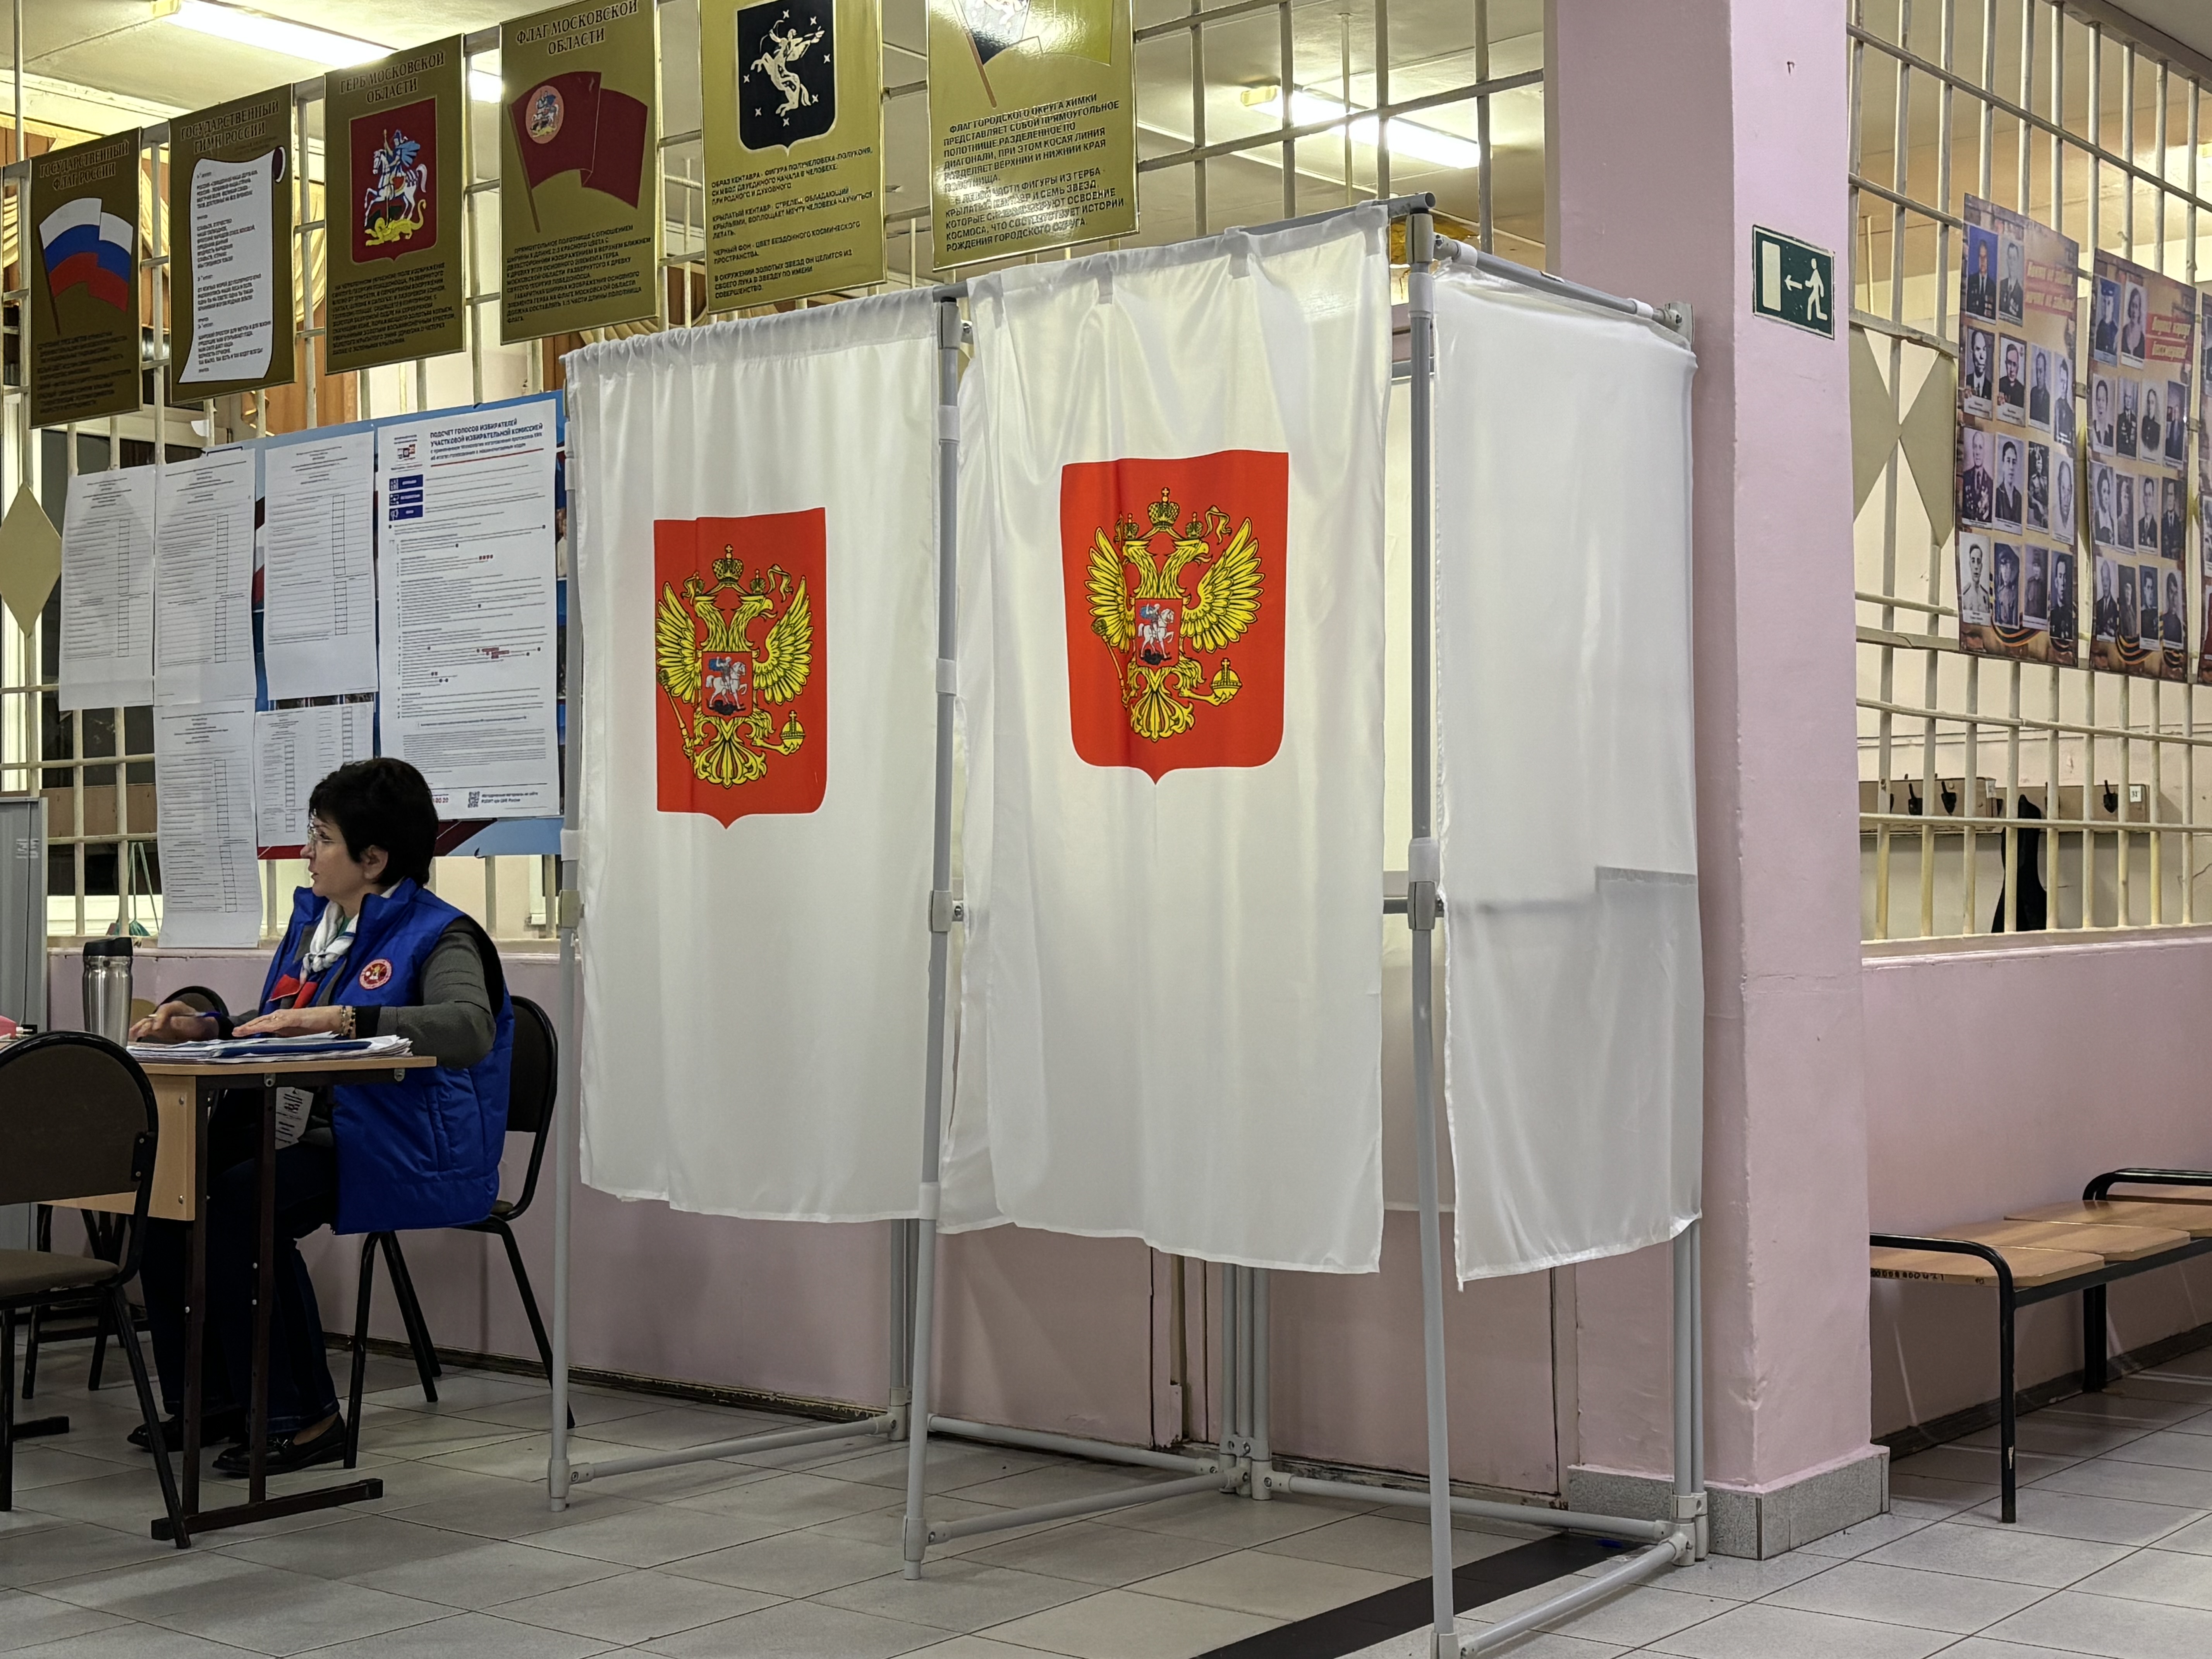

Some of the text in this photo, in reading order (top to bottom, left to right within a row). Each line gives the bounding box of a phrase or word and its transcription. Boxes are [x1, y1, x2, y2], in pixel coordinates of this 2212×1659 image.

[517, 24, 548, 45] ФЛАГ
[548, 28, 605, 55] ОБЛАСТИ
[340, 51, 445, 94] ГЕРБ МОСКОВСКОЙ
[367, 77, 418, 103] ОБЛАСТИ
[180, 99, 279, 141] ГОСУДАРСТВЕННЫЙ
[944, 125, 1007, 147] ПРЕДСТАВЛЯЕТ
[1042, 100, 1119, 124] ПРЯМОУГОЛЬНОЕ
[950, 93, 1096, 133] ФЛАГ ГОРОДСКОГО ОКРУГА ХИМКИ
[194, 134, 223, 154] ГИМН
[224, 121, 266, 146] РОССИИ
[998, 146, 1015, 158] ПРИ
[1018, 141, 1042, 153] ЭТОМ
[1044, 134, 1072, 148] КОСАЯ
[1075, 127, 1105, 141] ЛИНИЯ
[999, 125, 1061, 146] РАЗДЕЛЕННОЕ
[1063, 122, 1075, 132] ПО
[1036, 152, 1041, 161] И
[1083, 139, 1106, 151] КРАЯ
[1022, 175, 1057, 190] ФИГУРЫ
[1060, 172, 1071, 182] ИЗ
[1073, 166, 1100, 180] ГЕРБА
[1041, 185, 1064, 198] СЕМЬ
[946, 213, 985, 229] КОТОРЫЕ
[1068, 187, 1115, 205] ОСВОЕНИЕ
[991, 221, 1007, 232] ЧТО
[1082, 198, 1123, 214] ИСТОРИИ
[946, 236, 992, 253] РОЖДЕНИЯ
[994, 223, 1051, 243] ГОРОДСКОГО
[430, 418, 517, 438] ПОДСЧЕТ ГОЛОСОВ ИЗБИРАТЕЛЕЙ
[466, 428, 511, 441] ИЗБИРАТЕЛЬНОЙ
